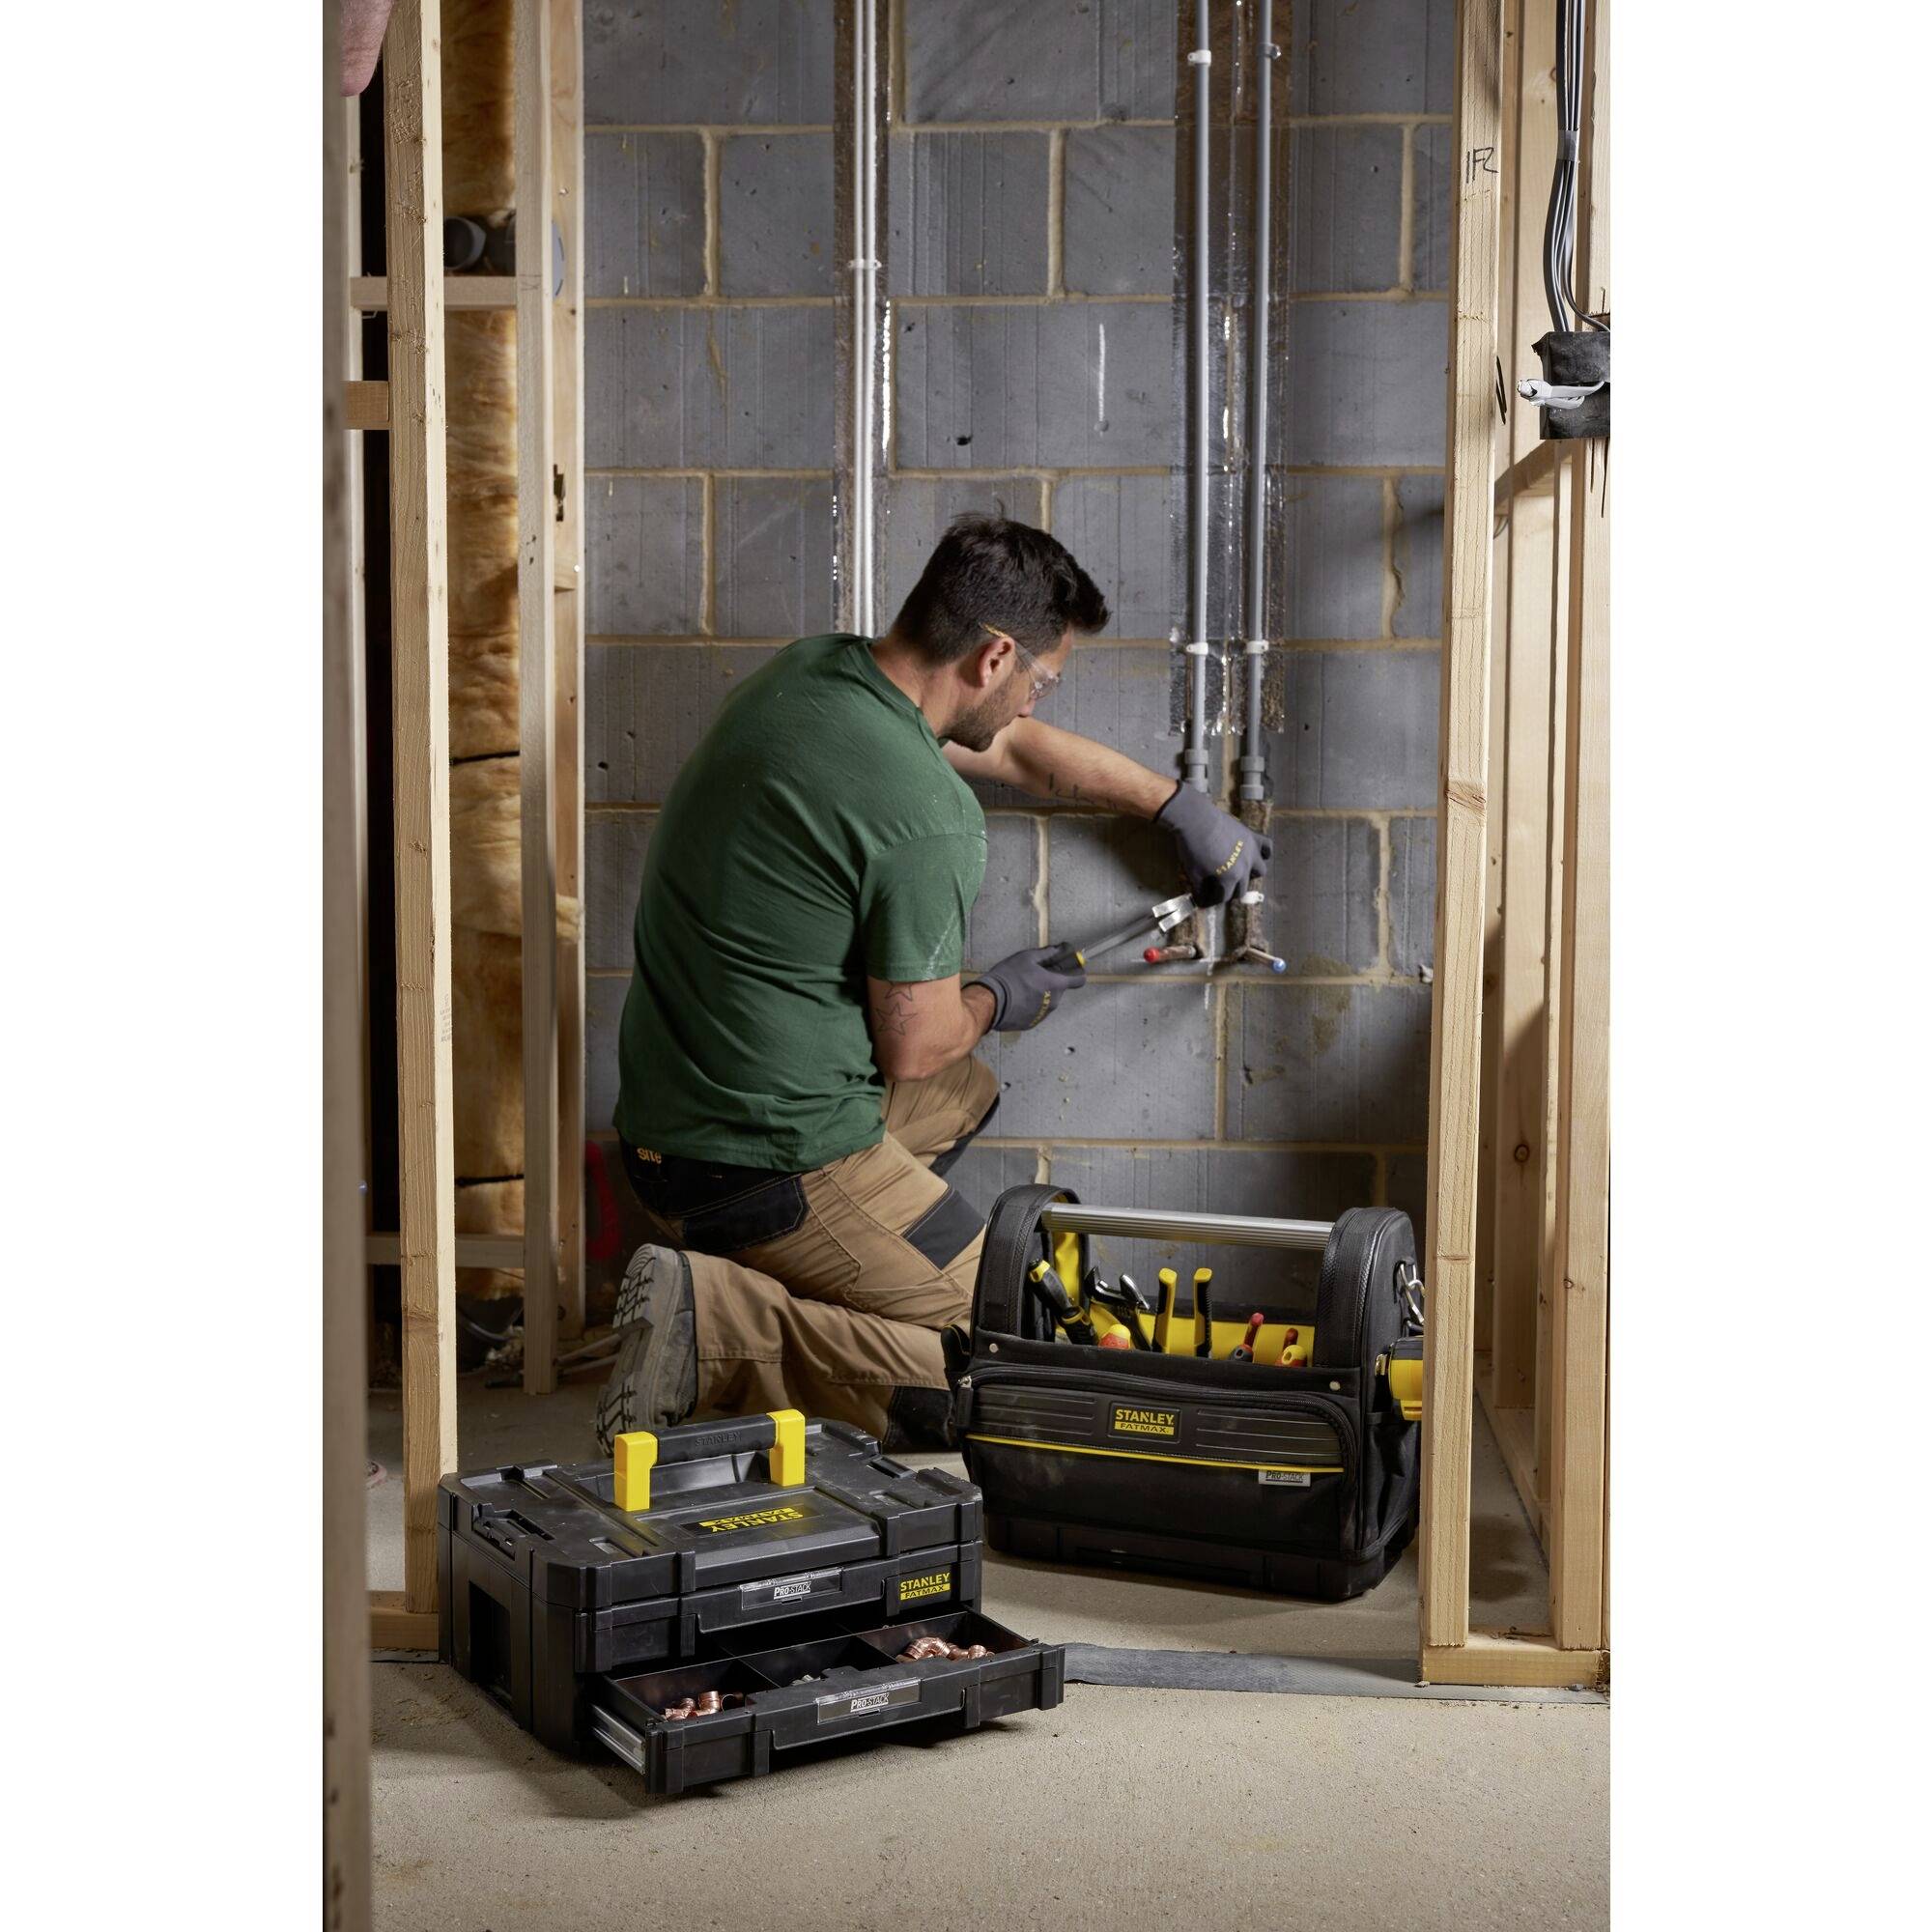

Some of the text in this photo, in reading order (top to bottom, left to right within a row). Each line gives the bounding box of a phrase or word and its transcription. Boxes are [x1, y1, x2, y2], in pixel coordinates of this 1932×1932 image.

[1116, 1408, 1175, 1425] STANLEY
[1120, 1421, 1167, 1434] FATMAX
[696, 1431, 742, 1446] STANLEY
[711, 1511, 804, 1534] STANLEY
[900, 1572, 951, 1592] STANLEY
[904, 1584, 945, 1599] FATMAX
